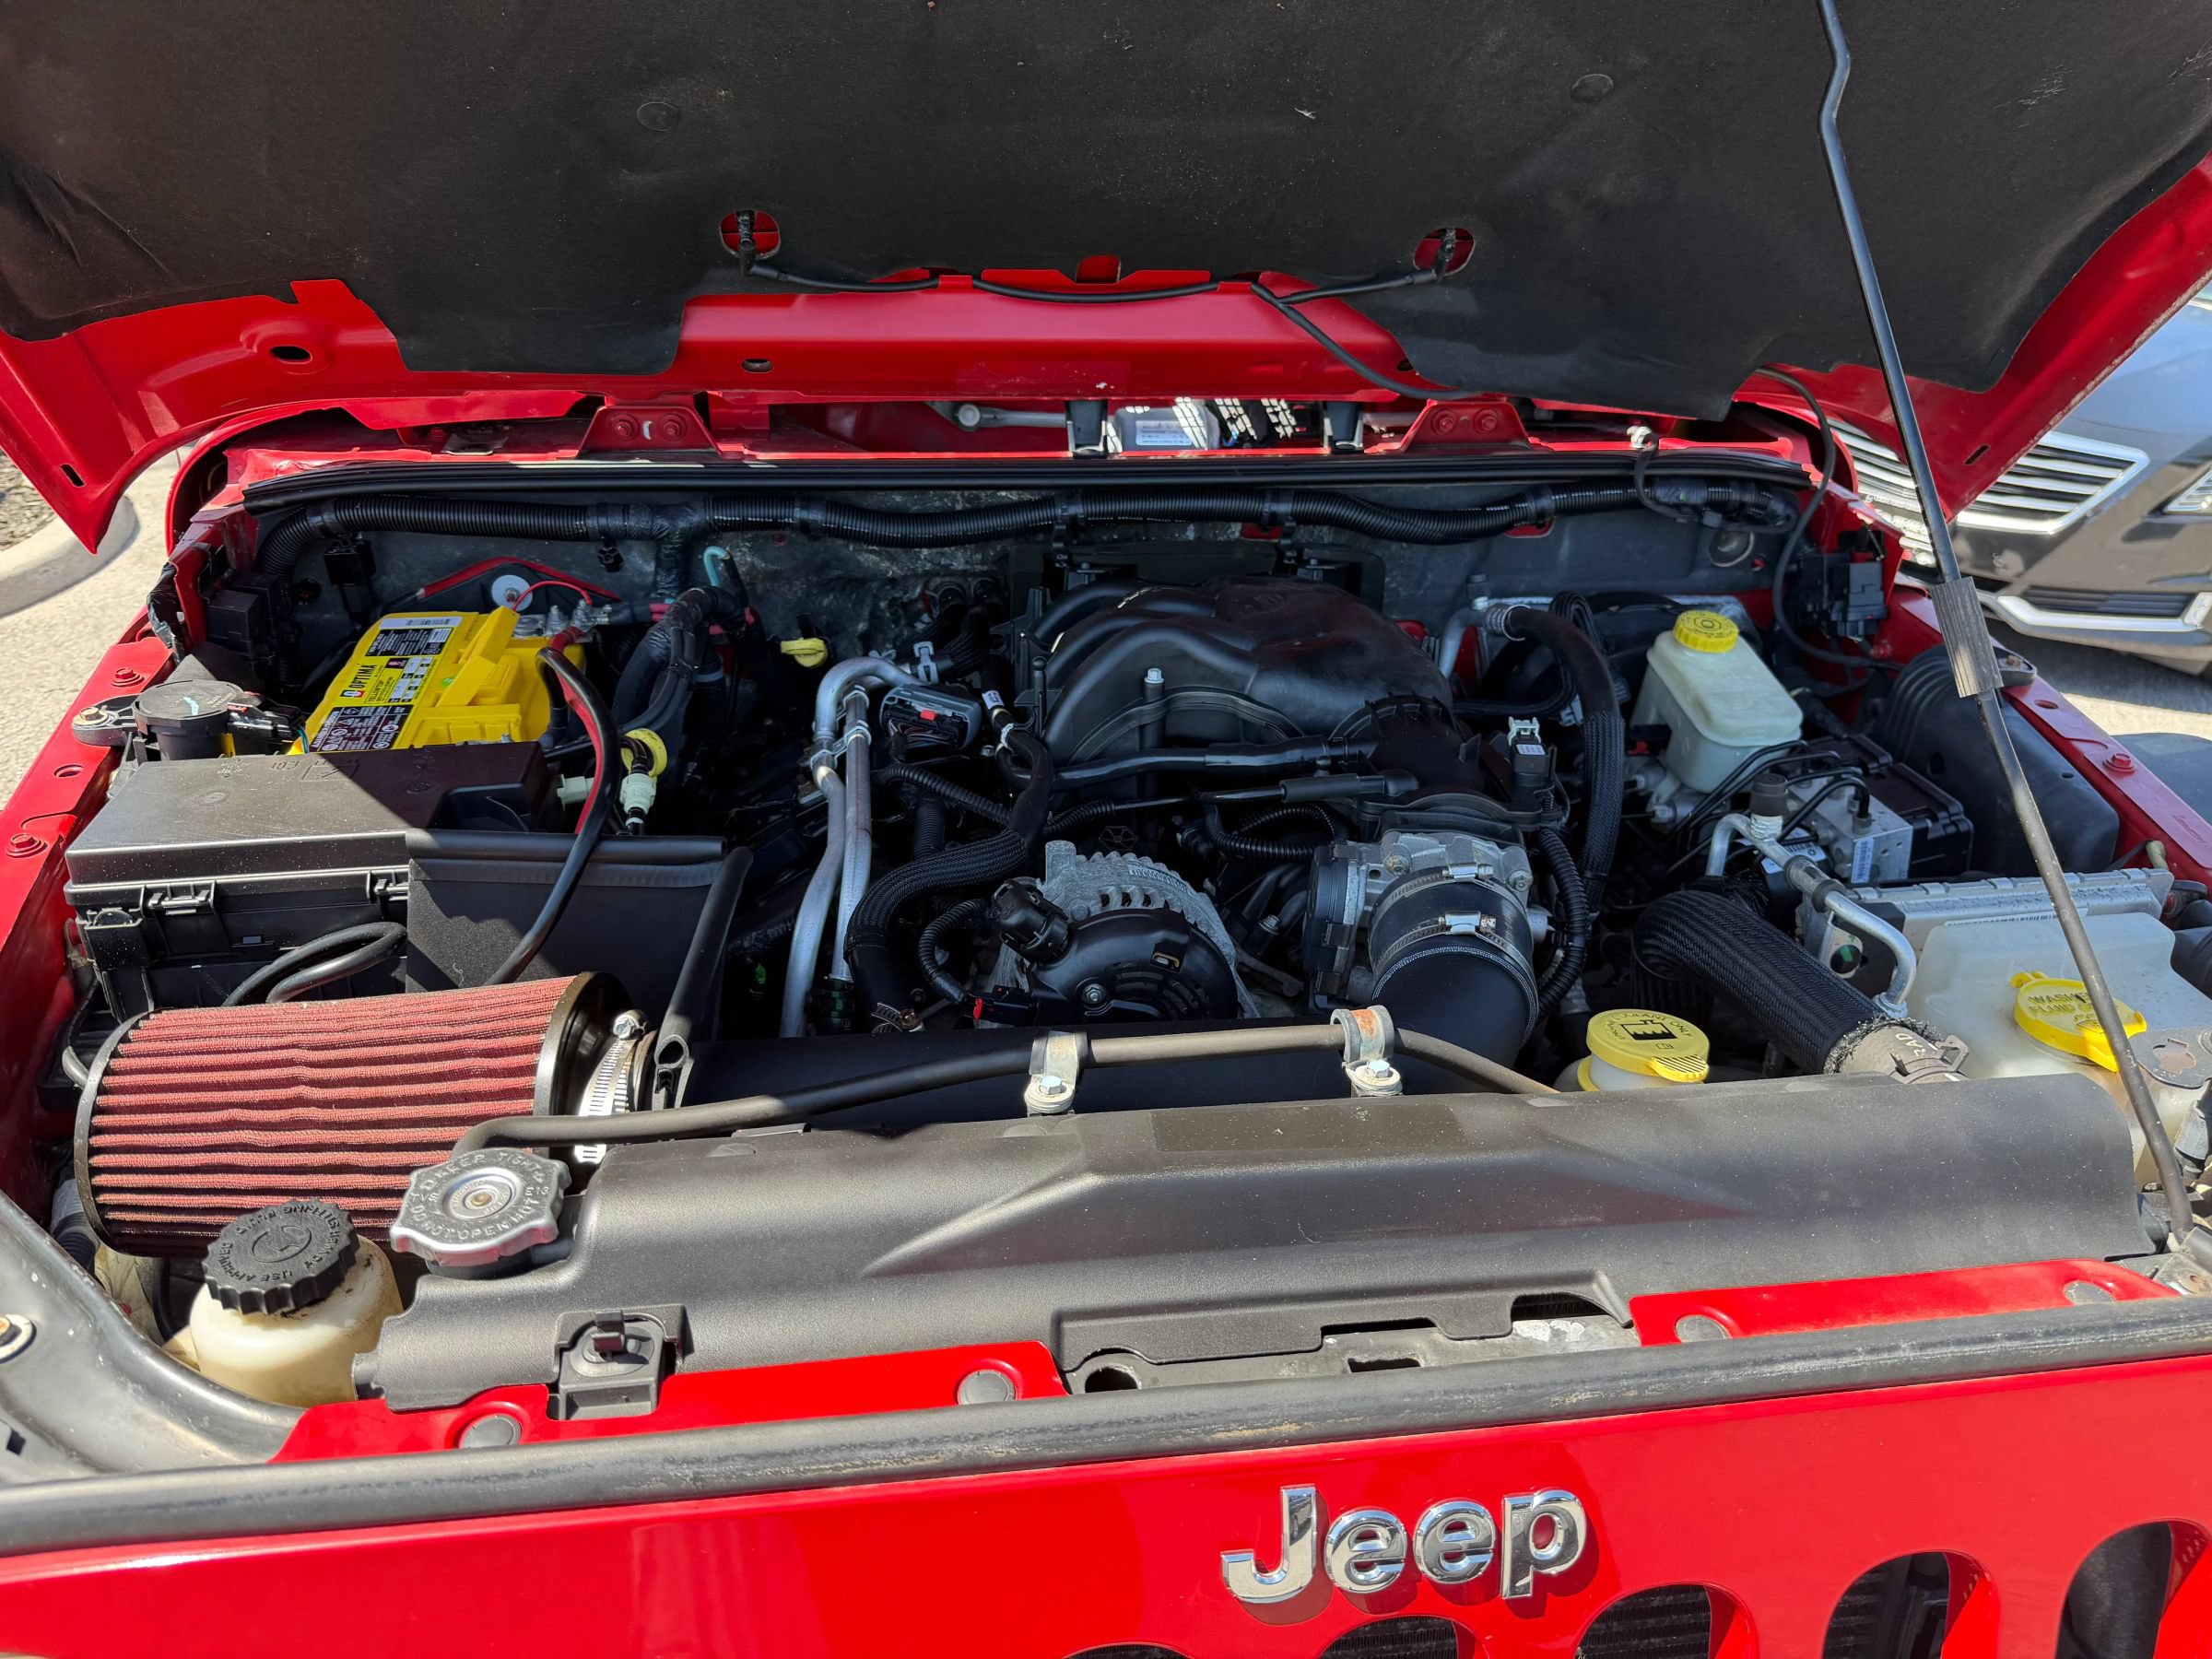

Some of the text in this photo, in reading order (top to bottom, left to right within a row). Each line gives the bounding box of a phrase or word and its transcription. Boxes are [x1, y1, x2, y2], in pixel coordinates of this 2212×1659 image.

[349, 665, 376, 688] OPTIMA
[1670, 1019, 1693, 1037] ONLY
[436, 1154, 487, 1179] KEEP
[260, 1270, 293, 1282] USE
[1220, 1483, 1587, 1603] Jeep
